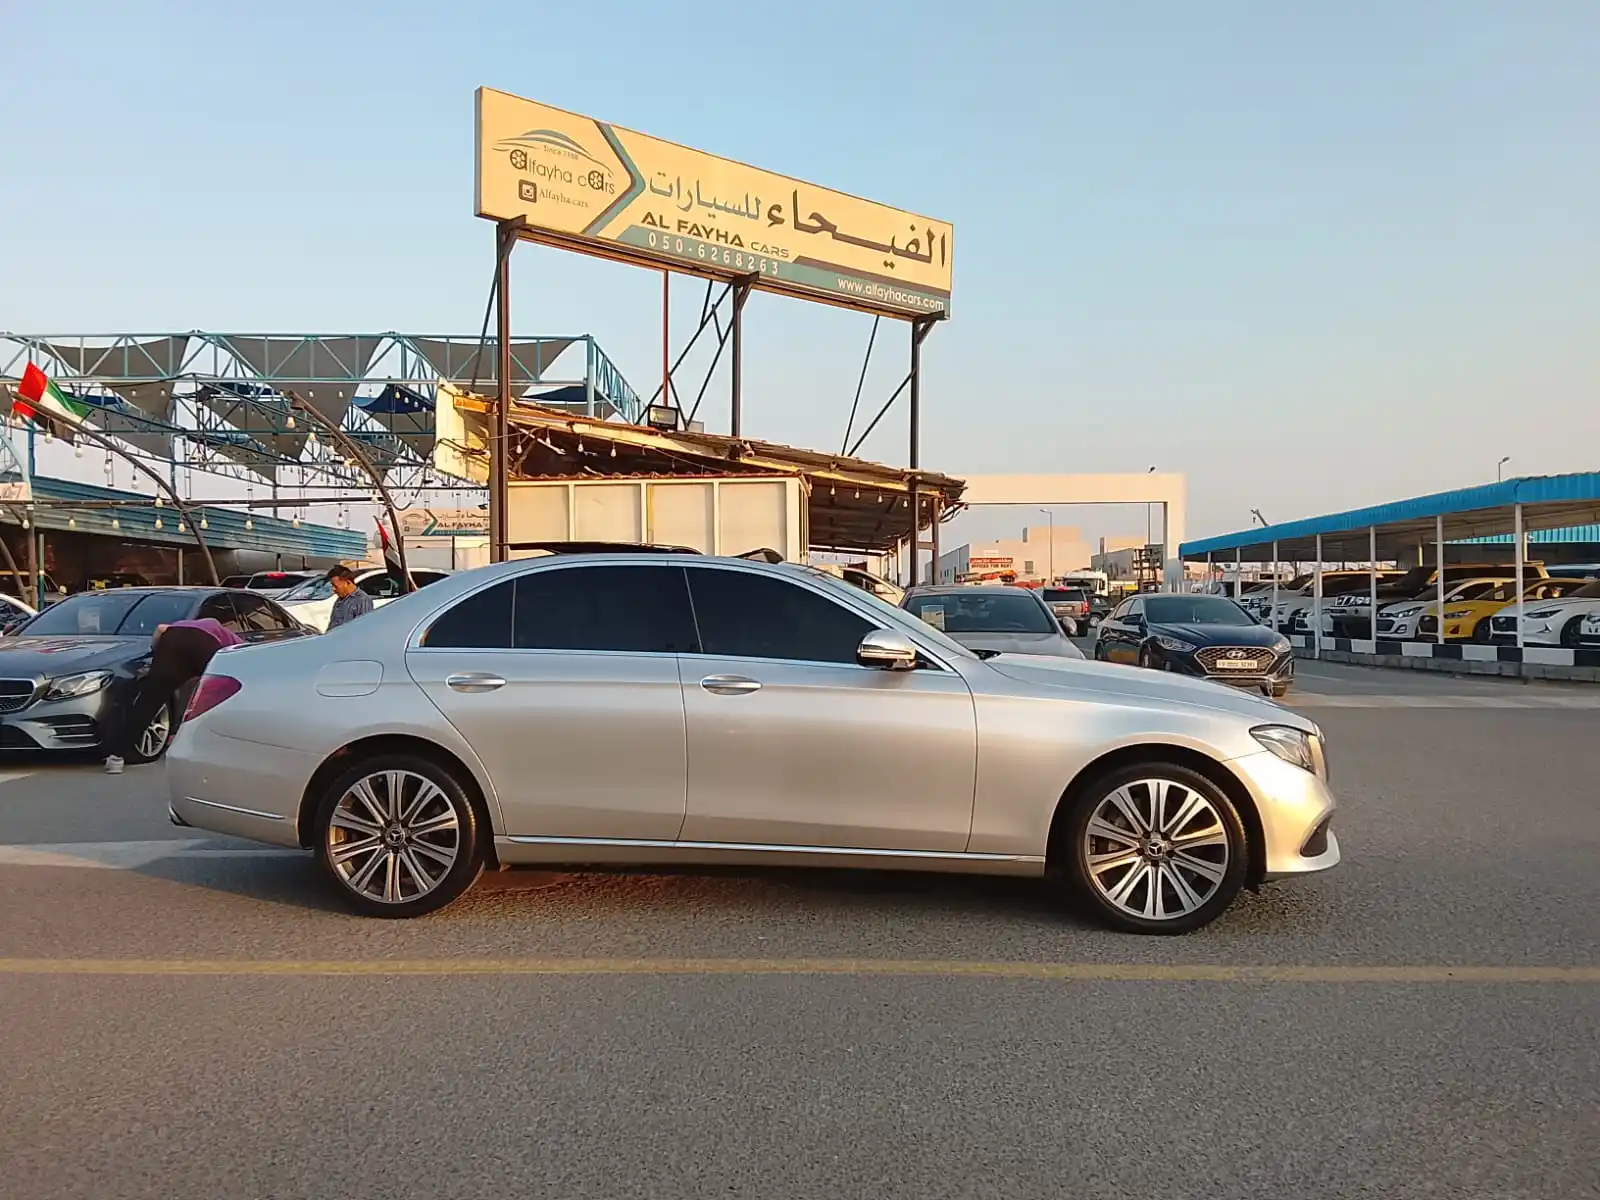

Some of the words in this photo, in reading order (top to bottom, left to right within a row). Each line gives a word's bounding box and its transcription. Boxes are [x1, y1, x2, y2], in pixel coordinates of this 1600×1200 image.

[509, 149, 573, 183] alfayha
[577, 170, 615, 195] cars
[648, 171, 761, 221] للسيارات
[641, 211, 670, 229] AL
[677, 219, 744, 248] FAYHA
[750, 241, 789, 258] CARS
[837, 277, 944, 310] www.alfayhacars.com
